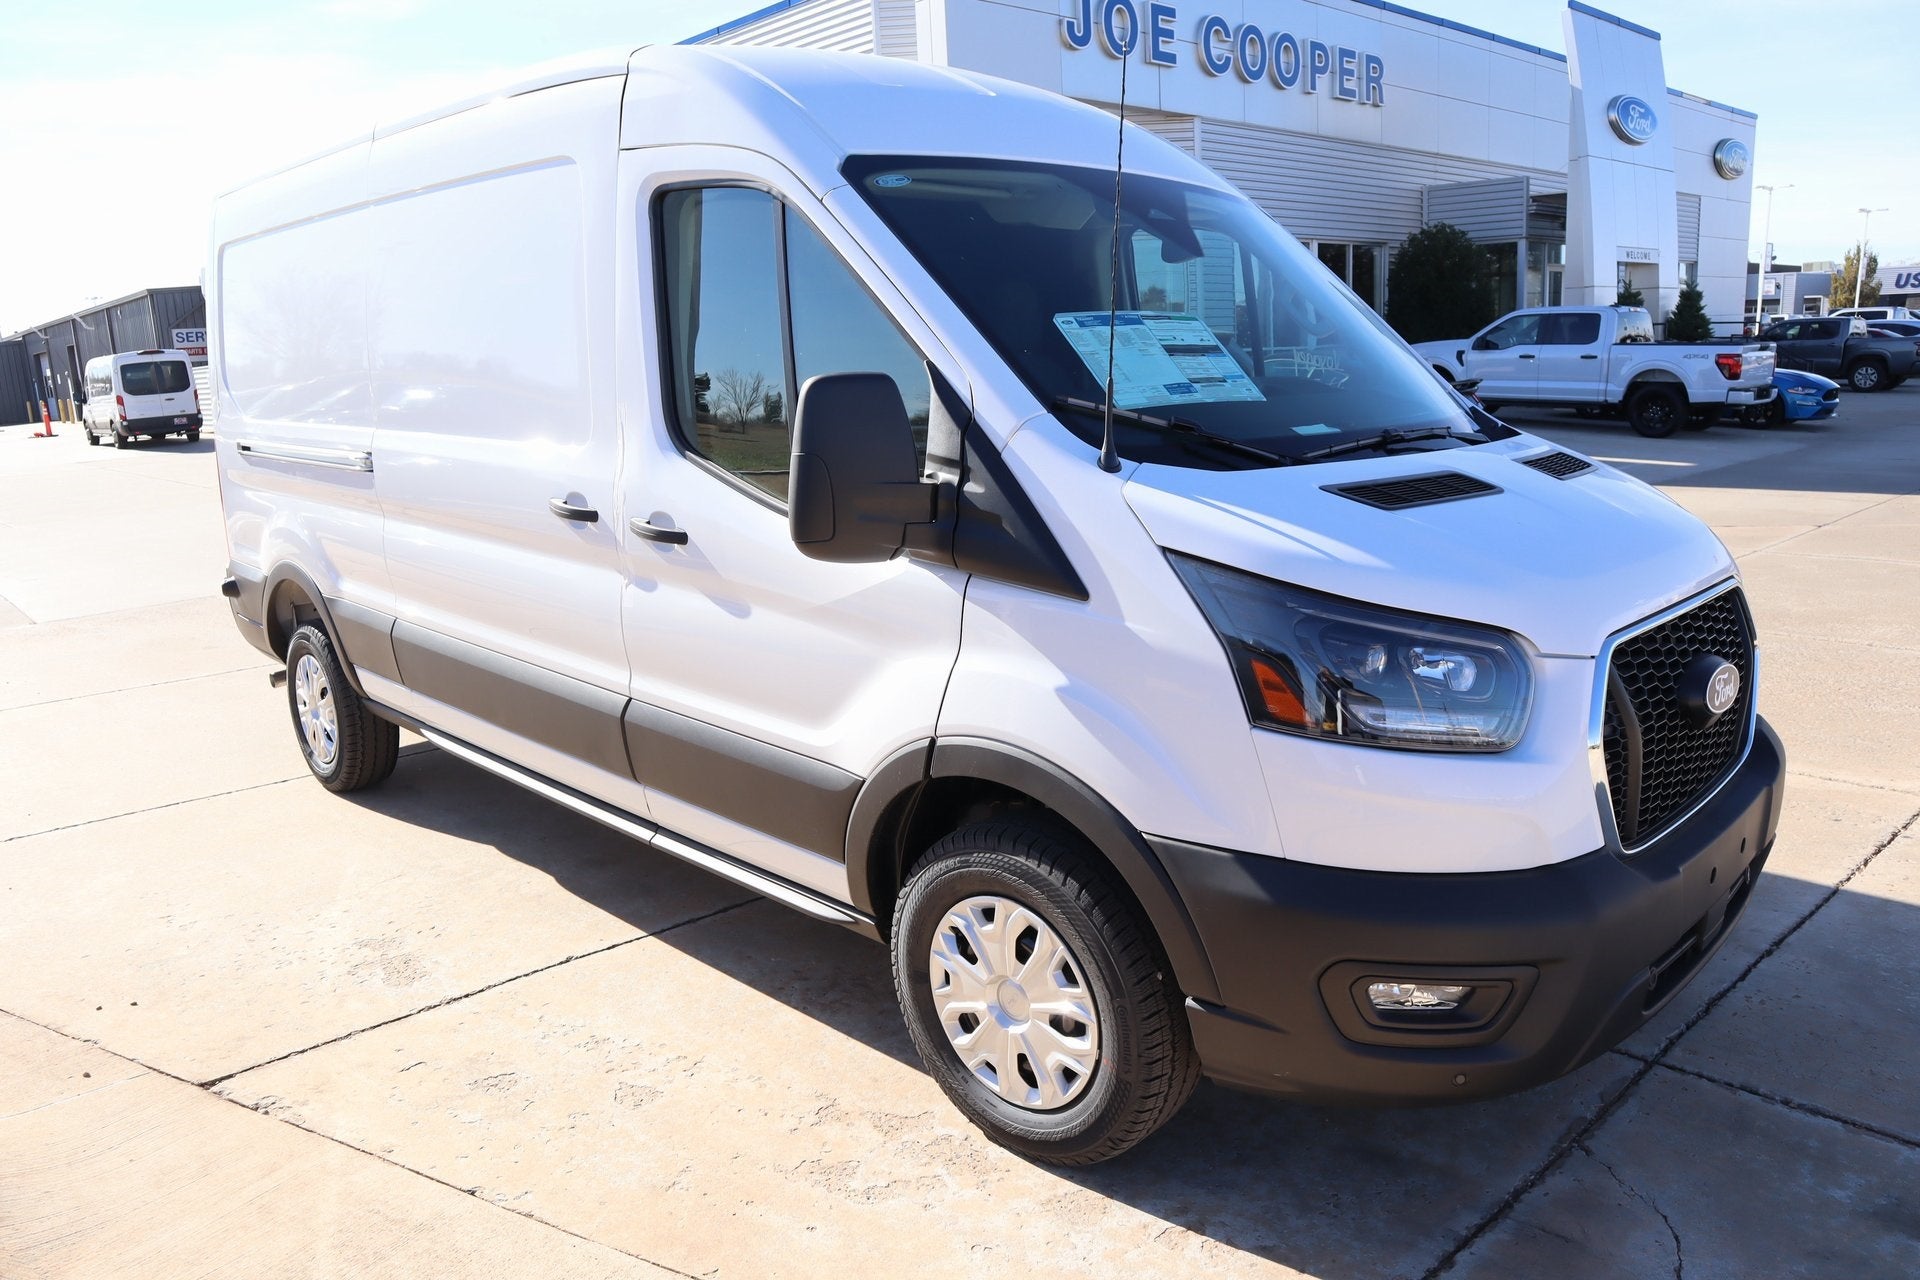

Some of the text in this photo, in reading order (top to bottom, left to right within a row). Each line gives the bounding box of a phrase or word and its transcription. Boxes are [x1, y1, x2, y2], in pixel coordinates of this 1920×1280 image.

[1061, 0, 1385, 106] JOE COOPER
[1628, 104, 1652, 133] Ford
[1625, 250, 1651, 261] WELCOME
[1714, 672, 1735, 706] Ford
